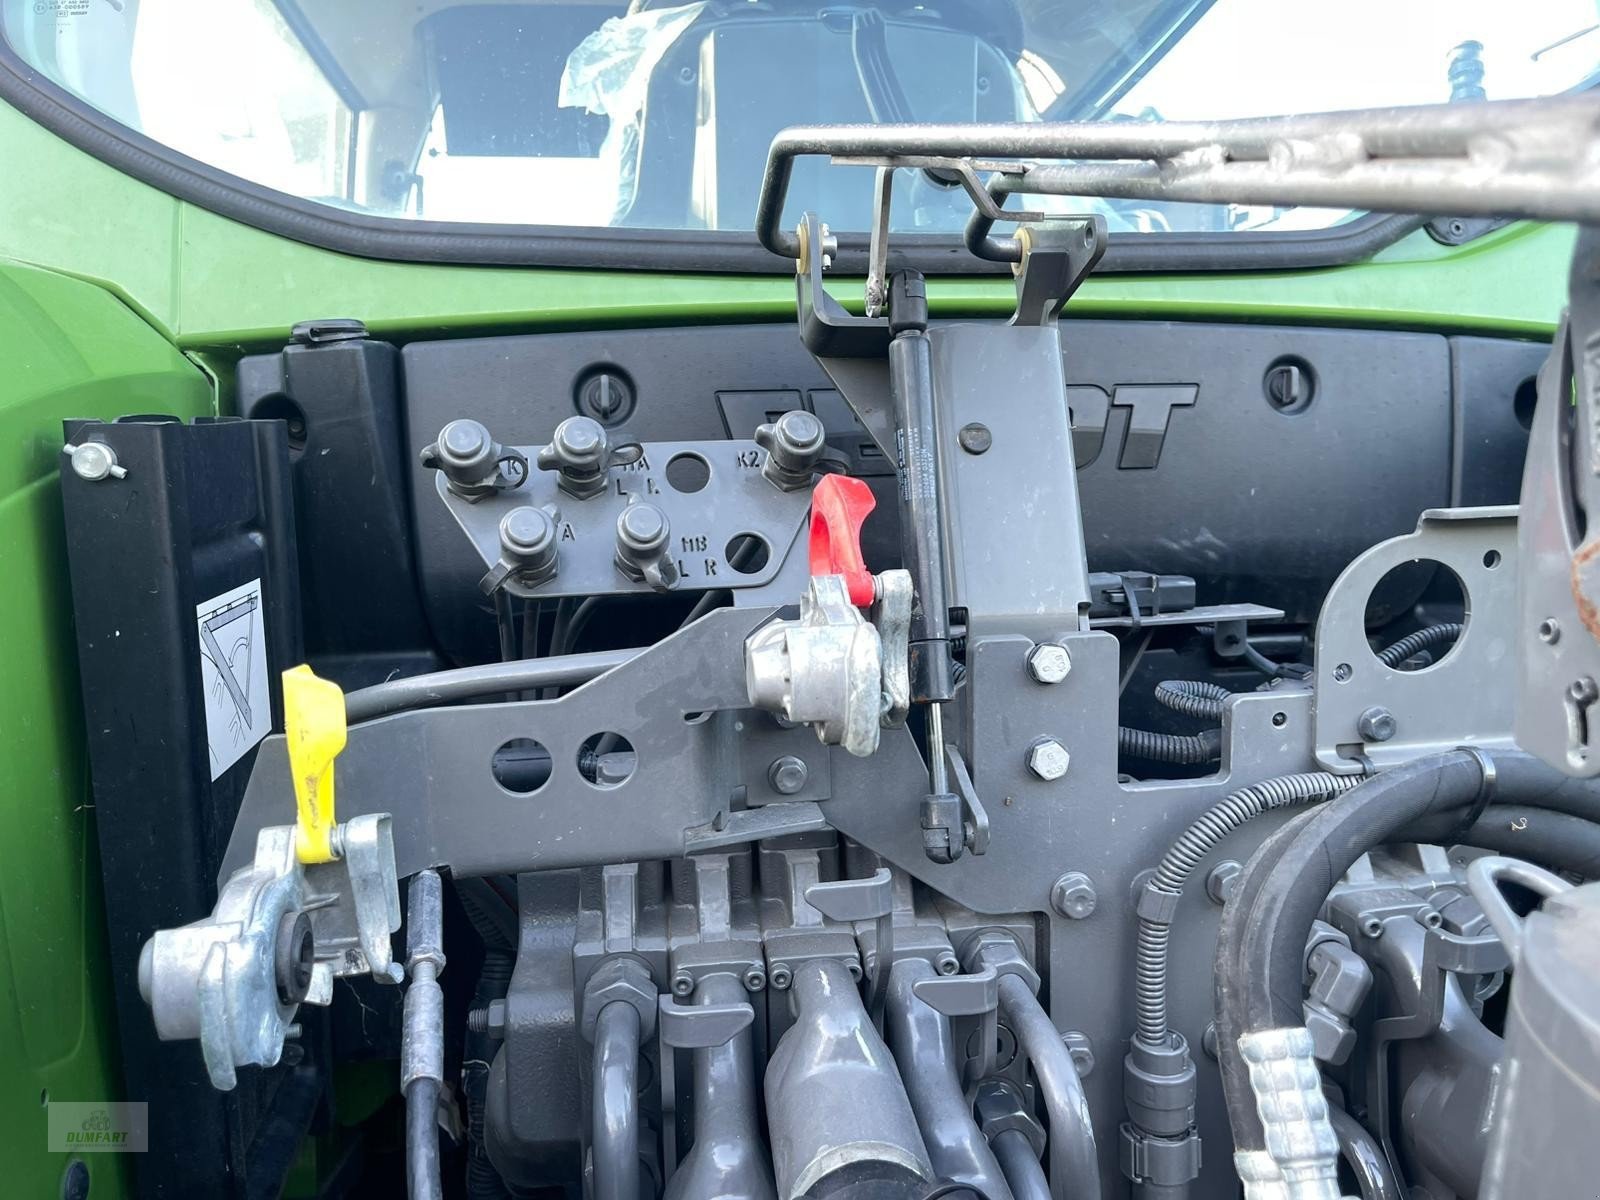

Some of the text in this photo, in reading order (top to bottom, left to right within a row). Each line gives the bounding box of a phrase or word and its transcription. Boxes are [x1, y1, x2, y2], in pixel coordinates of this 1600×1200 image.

[737, 451, 761, 469] K2
[616, 478, 628, 496] L
[561, 523, 575, 542] A
[678, 558, 718, 577] L R
